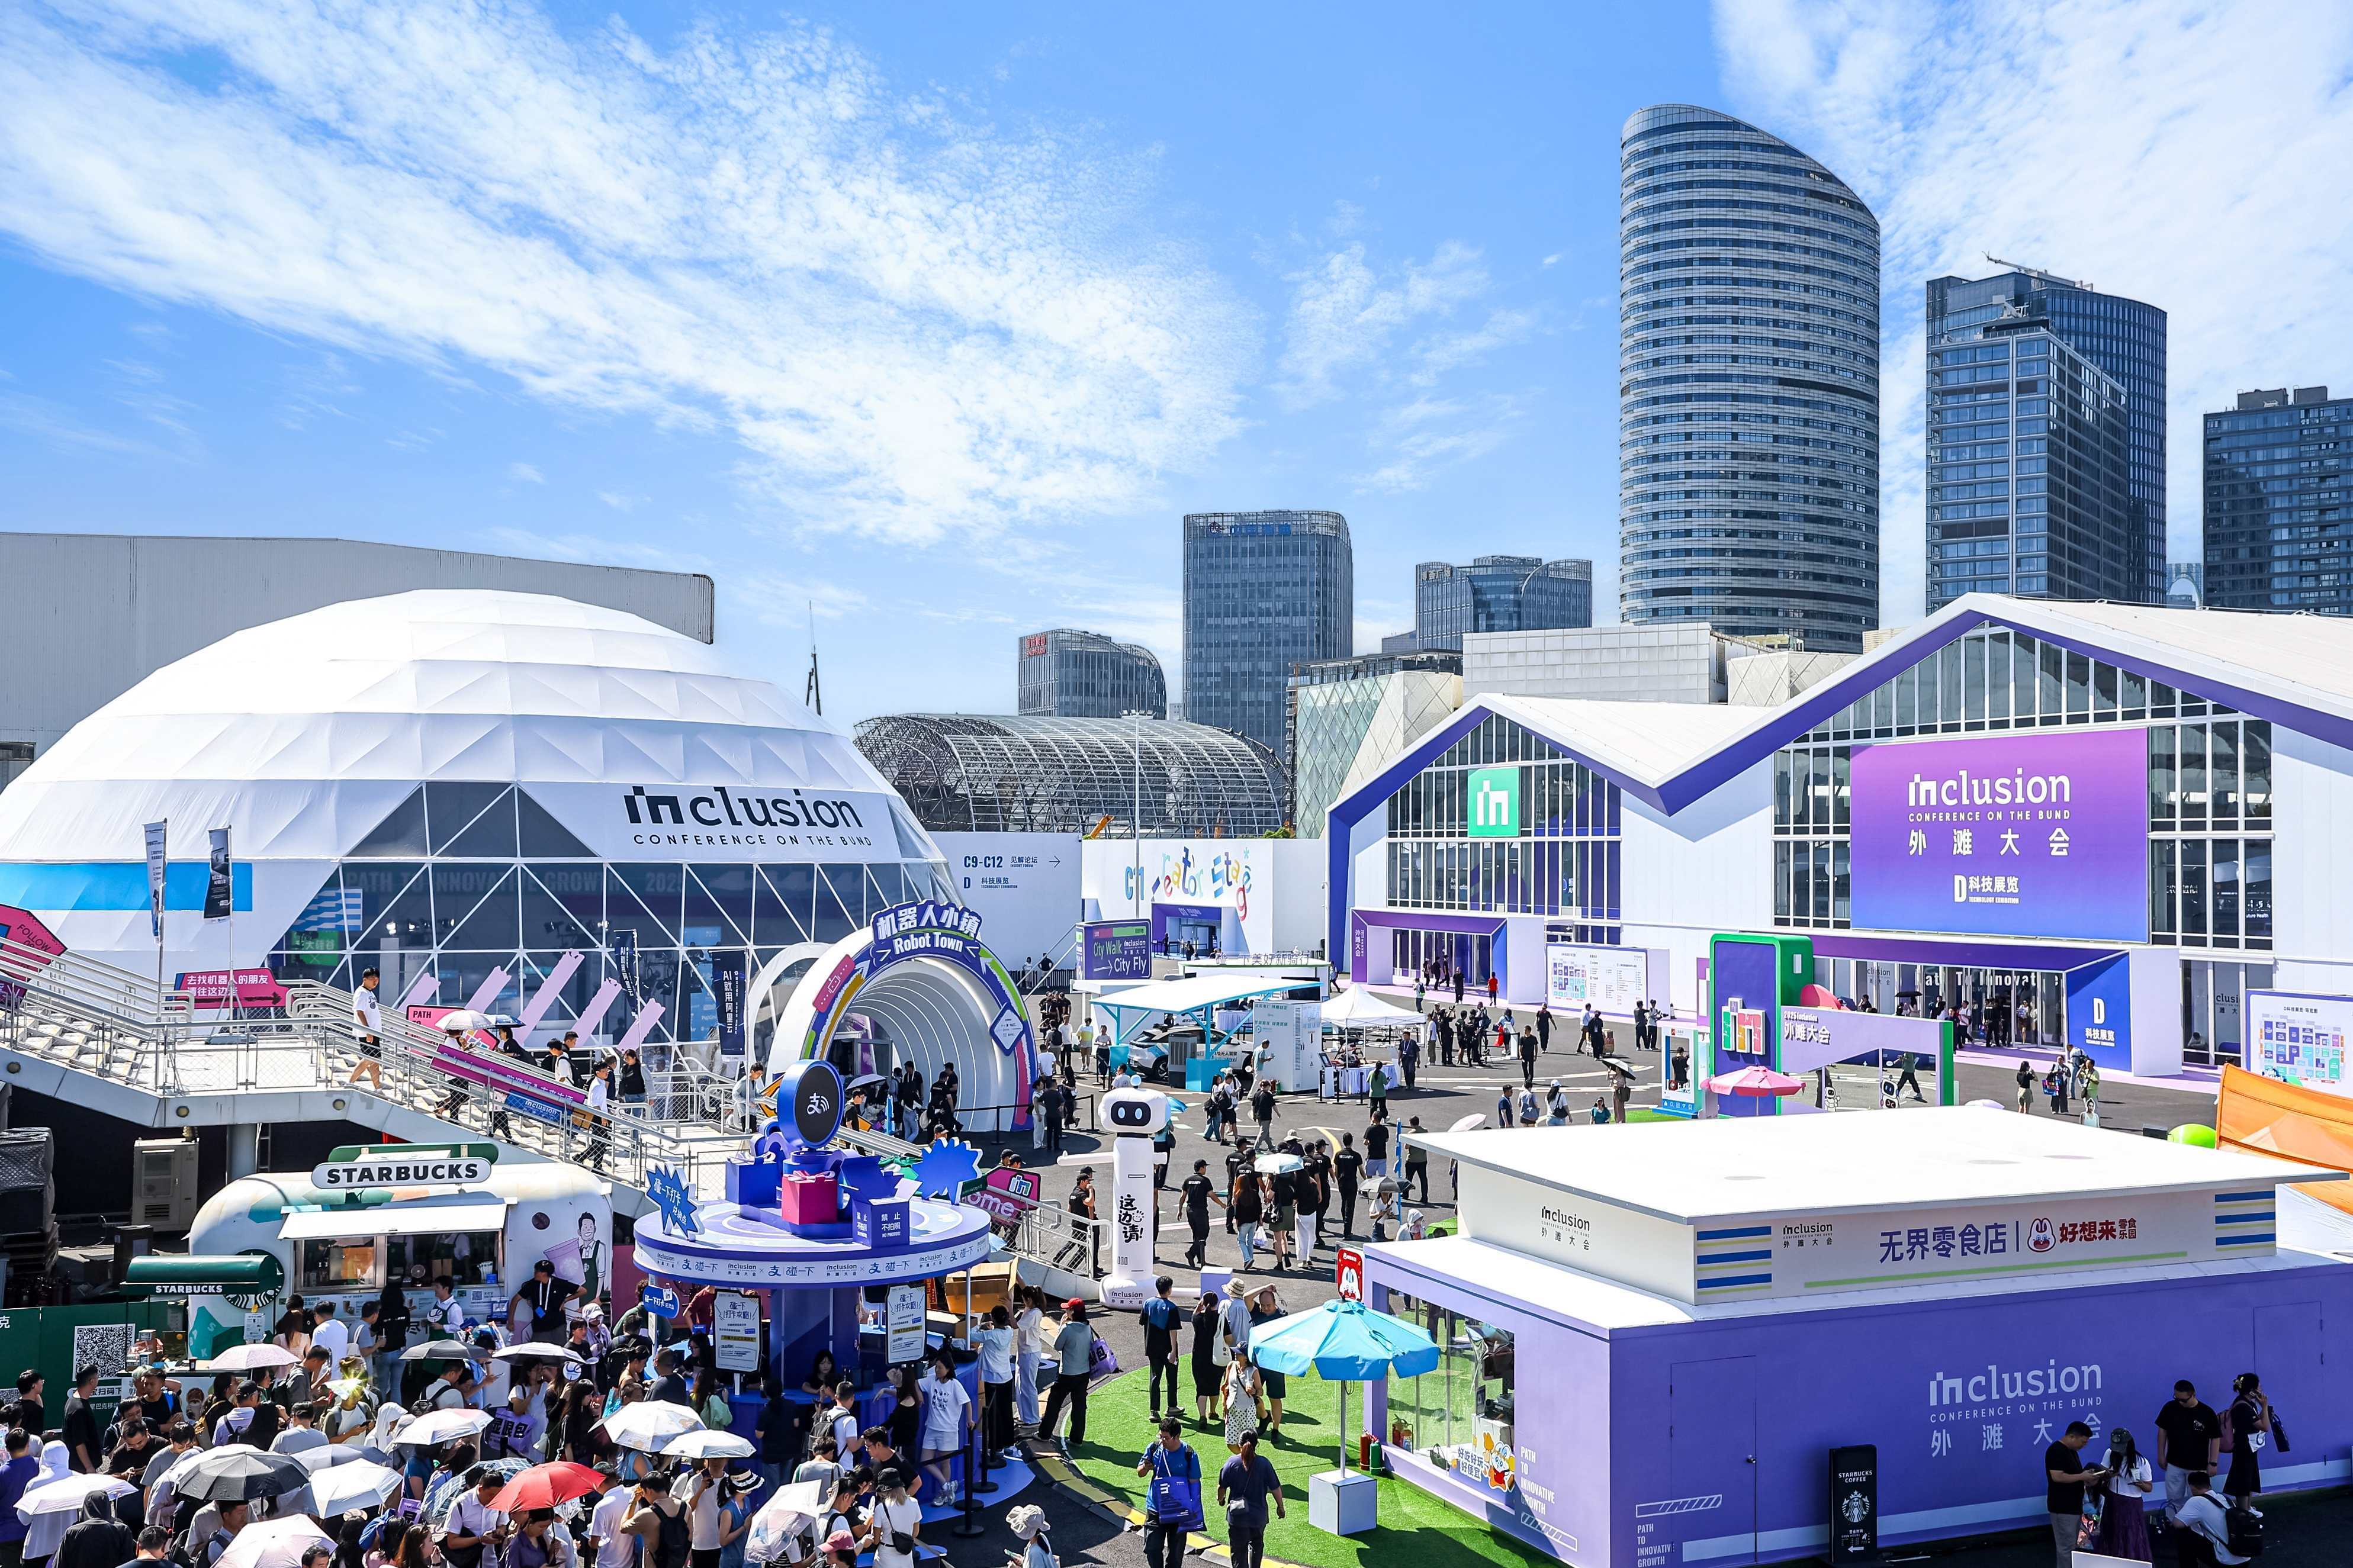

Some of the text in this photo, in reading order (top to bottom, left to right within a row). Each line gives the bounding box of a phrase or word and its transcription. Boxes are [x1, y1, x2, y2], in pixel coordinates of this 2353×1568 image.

[1908, 767, 2071, 807] inclusion
[623, 785, 864, 828] inclusion
[1908, 810, 2071, 822] CONFERENCE ON THE BUND
[633, 834, 872, 846] CONFERENCE ON THE BUND
[1908, 828, 2071, 856] 外滩大会
[963, 855, 1003, 868] C9-C12
[963, 877, 971, 889] D
[1953, 874, 2020, 903] D 科技展览
[876, 904, 981, 940] 机器人小镇
[17, 923, 52, 952] FOLLOW
[893, 932, 964, 955] Robot Town
[1124, 939, 1146, 947] inclusion
[1093, 939, 1123, 960] City Walk
[1114, 955, 1147, 975] City Fly
[722, 970, 734, 1033] AI就用阿里云
[2092, 997, 2106, 1025] D
[413, 1010, 432, 1019] PATH
[326, 1163, 478, 1184] STARBUCKS
[881, 1222, 901, 1231] 不拍照
[1541, 1205, 1590, 1232] inclusion
[2118, 1217, 2137, 1229] 零食
[1783, 1222, 1833, 1235] inclusion
[2118, 1227, 2137, 1239] 乐园
[1541, 1226, 1590, 1251] 外滩大会
[1879, 1219, 2117, 1264] 无界零食店 好想来
[657, 1252, 676, 1261] inclusion
[885, 1260, 911, 1272] 碰一下
[919, 1253, 943, 1263] inclusion
[695, 1260, 718, 1273] 碰一下
[786, 1266, 815, 1277] 碰一下
[155, 1284, 223, 1294] STARBUCKS
[1929, 1358, 2102, 1406] inclusion
[1930, 1396, 2102, 1424] CONFERENCE ON THE BUND
[1931, 1412, 2102, 1458] 外滩大会
[1457, 1446, 1484, 1469] 好吃好玩
[1520, 1445, 1536, 1464] PATH
[1520, 1461, 1529, 1476] TO
[1838, 1470, 1872, 1478] STARBUCKS
[1521, 1476, 1555, 1505] INNOVATIVE
[1521, 1492, 1547, 1516] GROWTH
[1637, 1523, 1654, 1534] PATH
[1637, 1535, 1646, 1545] TO
[1637, 1556, 1666, 1568] GROWTH
